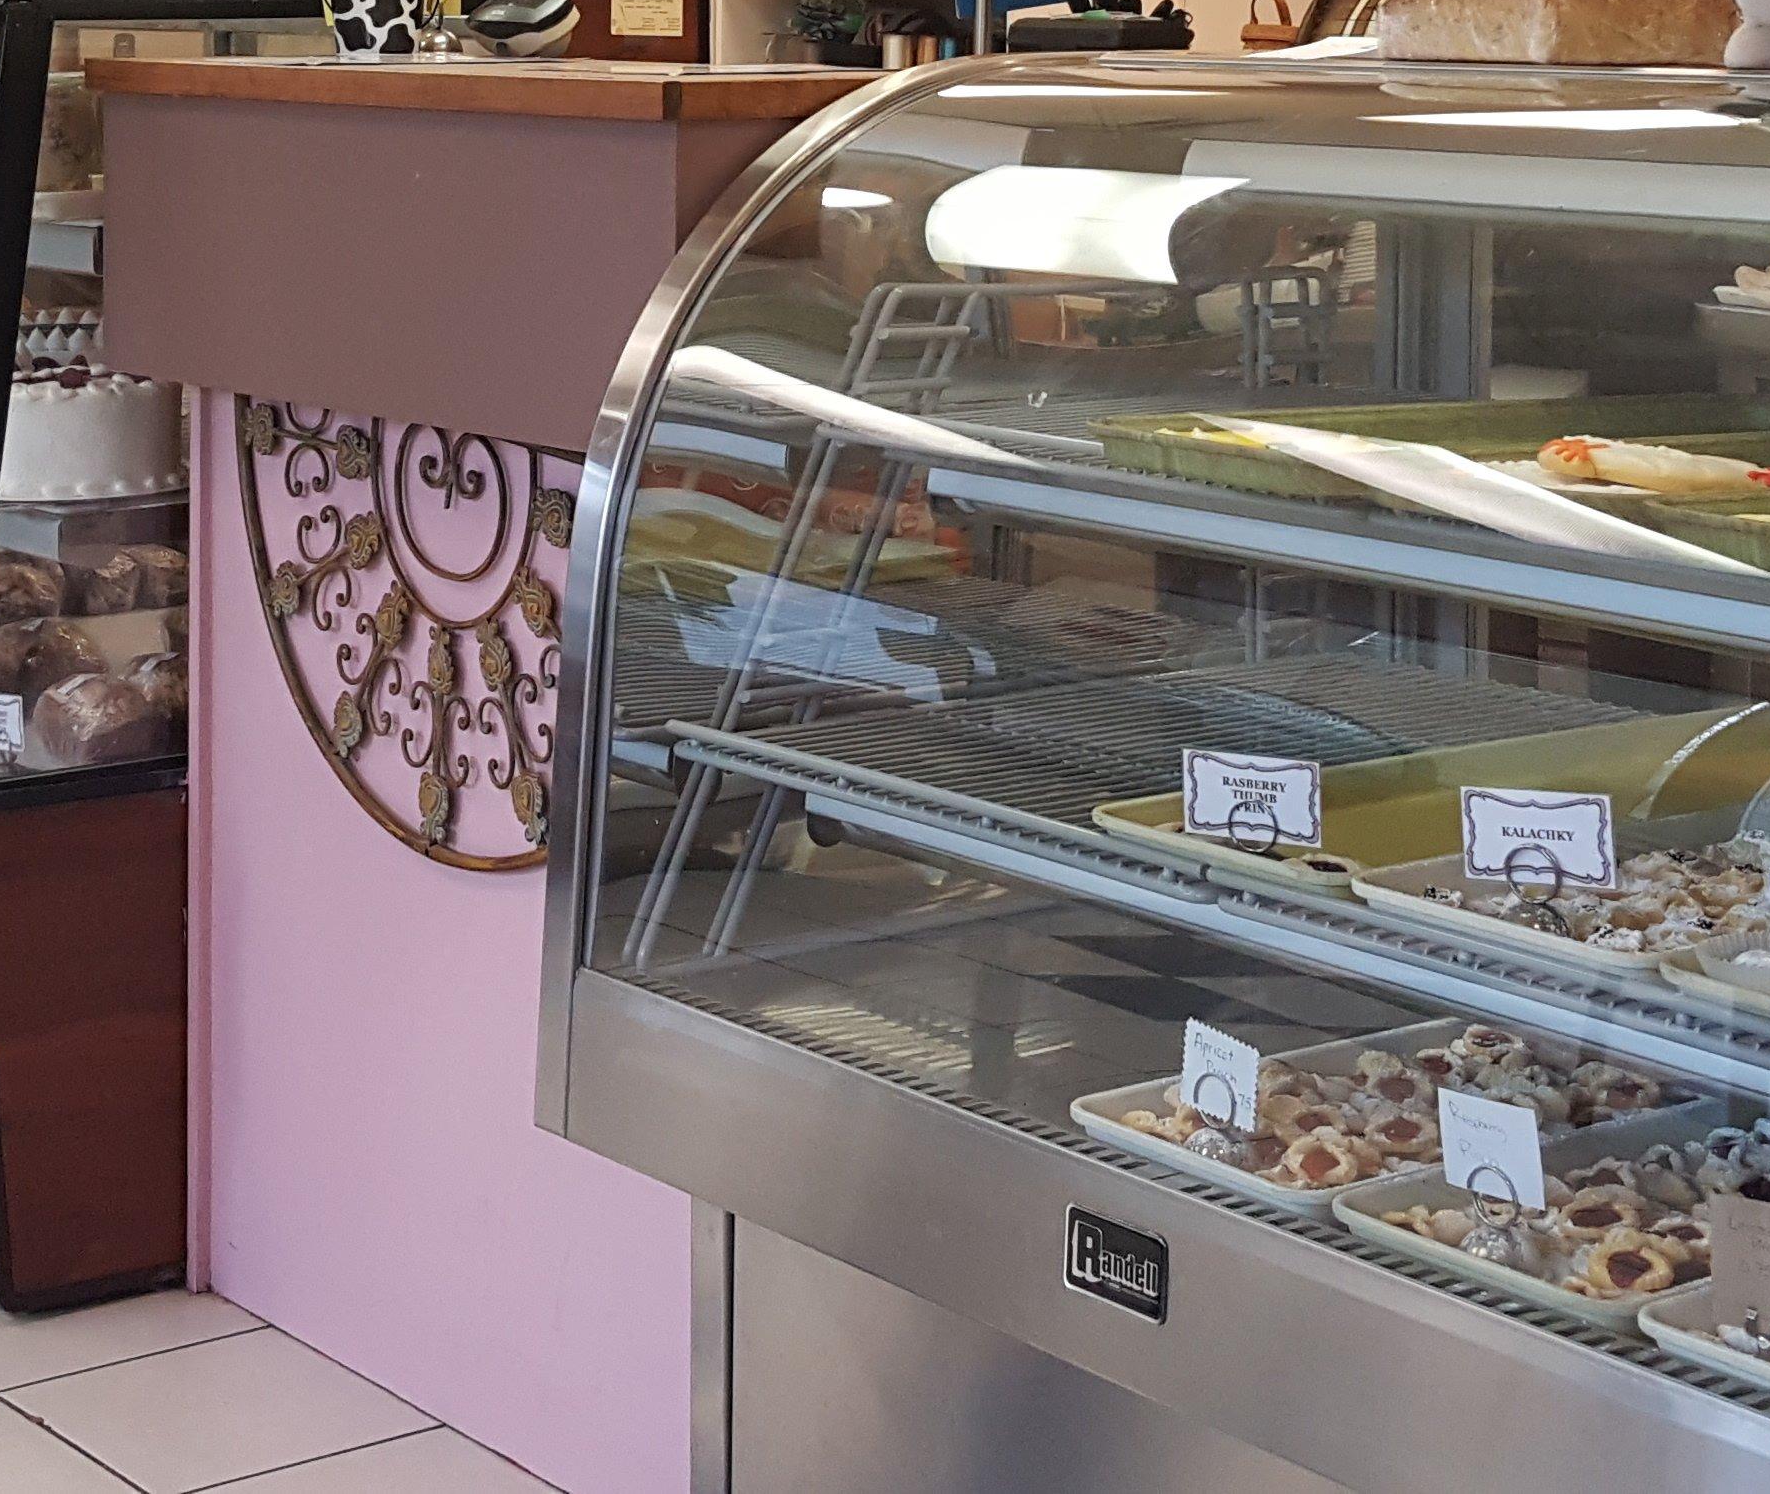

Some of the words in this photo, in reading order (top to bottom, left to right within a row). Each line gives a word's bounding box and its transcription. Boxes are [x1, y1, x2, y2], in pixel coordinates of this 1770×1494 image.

[1222, 776, 1287, 793] RASBERRY
[1232, 789, 1277, 804] THUMB
[1502, 826, 1575, 842] KALACHKY
[1194, 1032, 1234, 1062] Apricot
[1072, 1219, 1159, 1297] Randell
